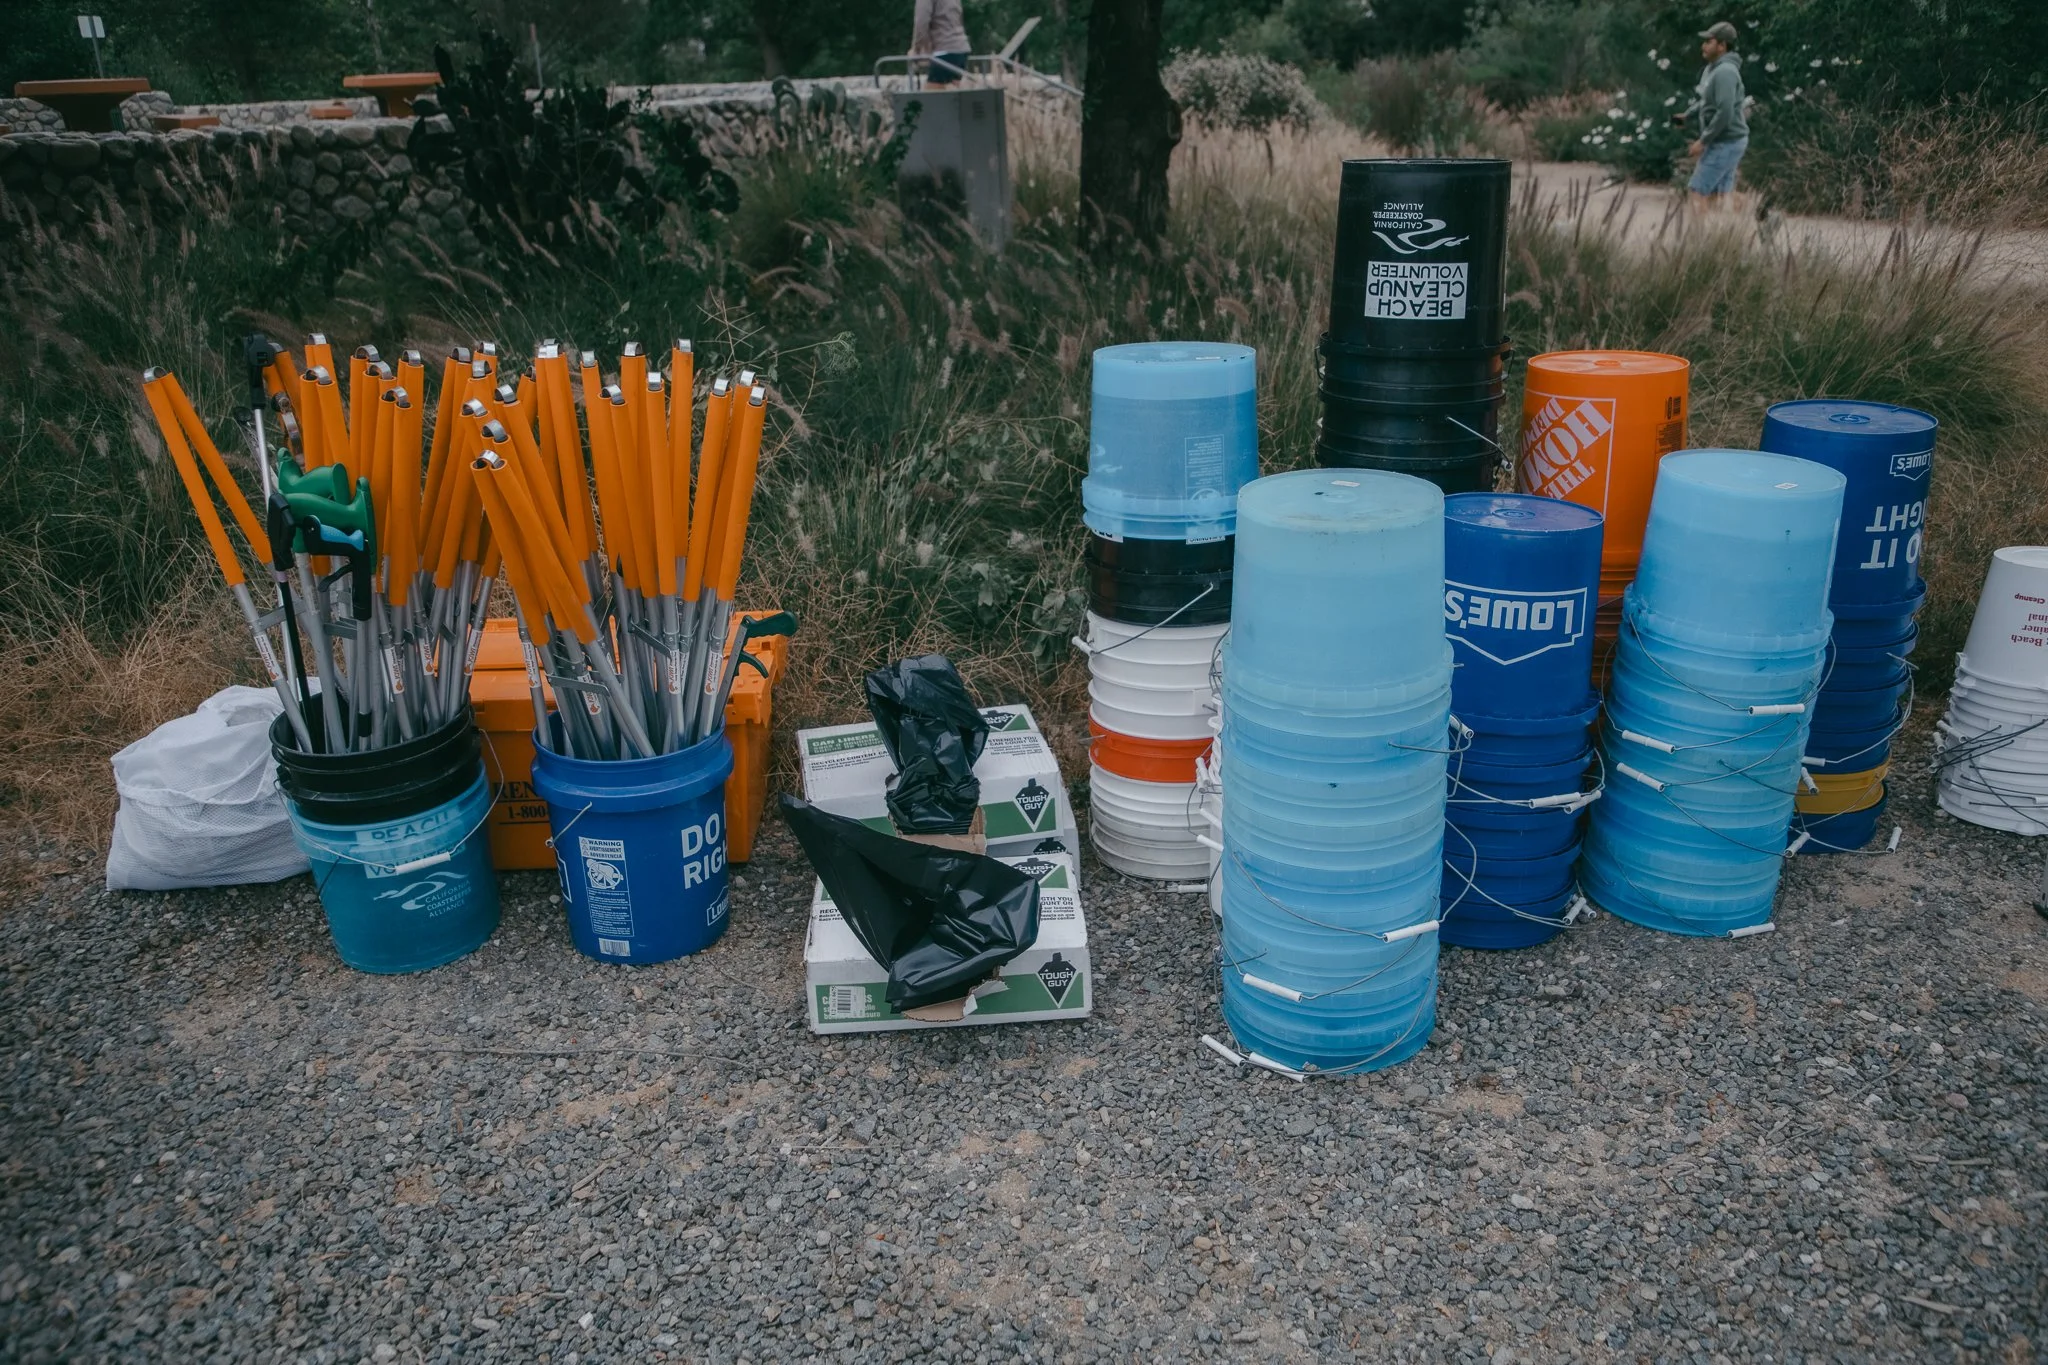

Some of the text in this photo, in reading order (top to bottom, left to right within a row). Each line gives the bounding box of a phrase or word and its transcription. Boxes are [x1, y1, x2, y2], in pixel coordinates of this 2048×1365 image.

[1383, 202, 1424, 210] ALLIANCE
[1373, 220, 1423, 229] CALIFORNIA
[1371, 264, 1463, 279] VOLUNTEER
[1368, 279, 1465, 298] CLEANUP
[1377, 299, 1453, 318] BEACH
[1518, 400, 1612, 494] HOM
[1865, 498, 1928, 533] IGHT
[1860, 538, 1898, 569] IT
[2014, 593, 2045, 604] Cleanup
[1444, 589, 1574, 635] LOWE'S
[2010, 634, 2043, 647] Beach
[812, 734, 876, 747] CAN LINERS
[1017, 794, 1047, 804] TOUGH
[1024, 802, 1042, 811] GUY
[681, 813, 721, 859] DO
[683, 839, 728, 890] RIGH
[1040, 971, 1074, 980] TOUGH
[1047, 979, 1068, 987] GUY
